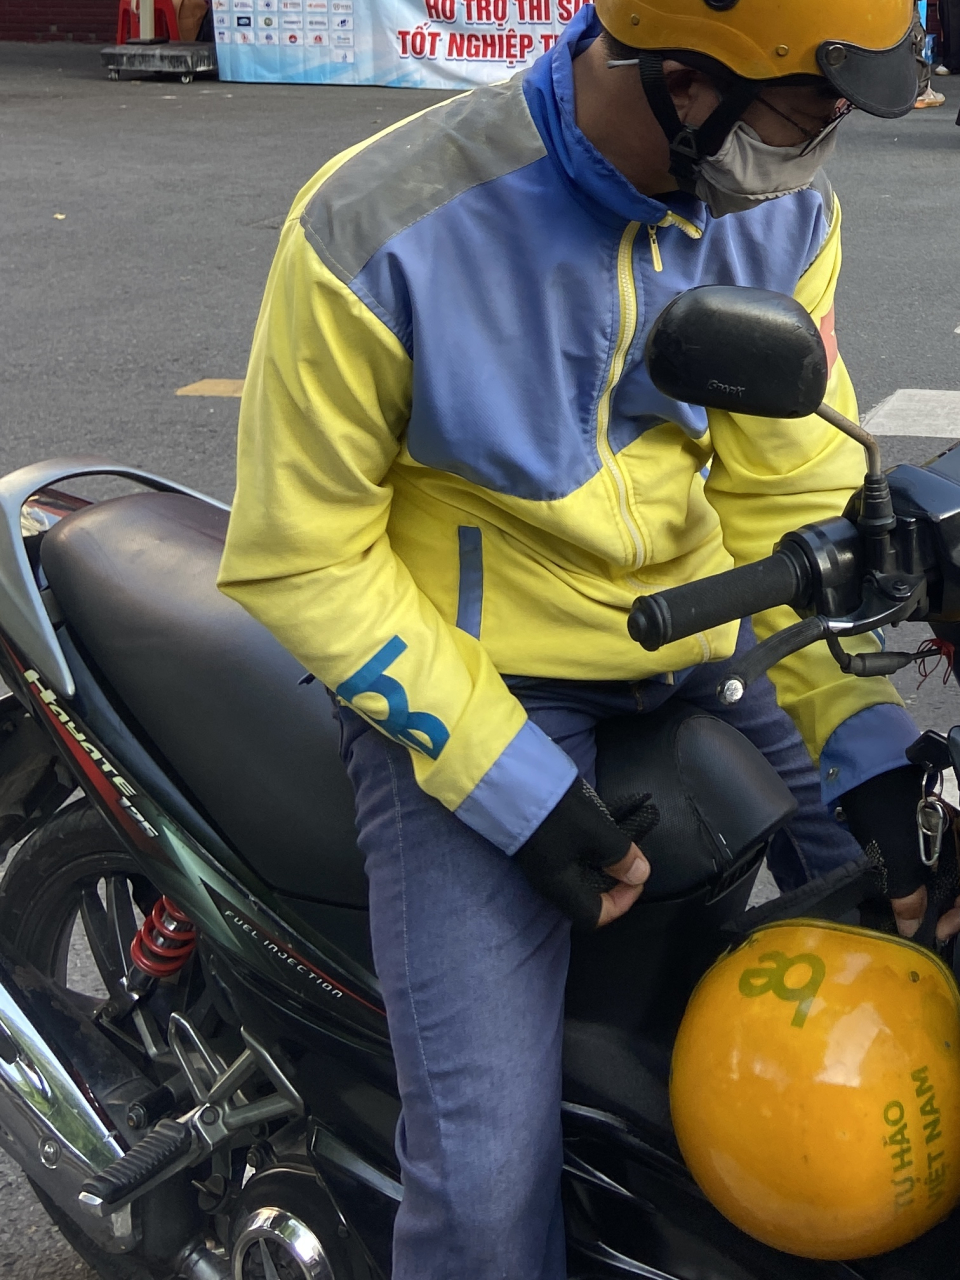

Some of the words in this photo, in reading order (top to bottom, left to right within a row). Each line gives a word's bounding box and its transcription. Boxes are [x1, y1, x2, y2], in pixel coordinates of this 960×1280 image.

[398, 22, 441, 59] TỐT
[448, 29, 535, 65] NGHIỆP
[116, 796, 160, 838] 125
[225, 909, 259, 940] FUEL
[263, 940, 345, 999] INJECTION
[910, 1065, 942, 1145] NAM
